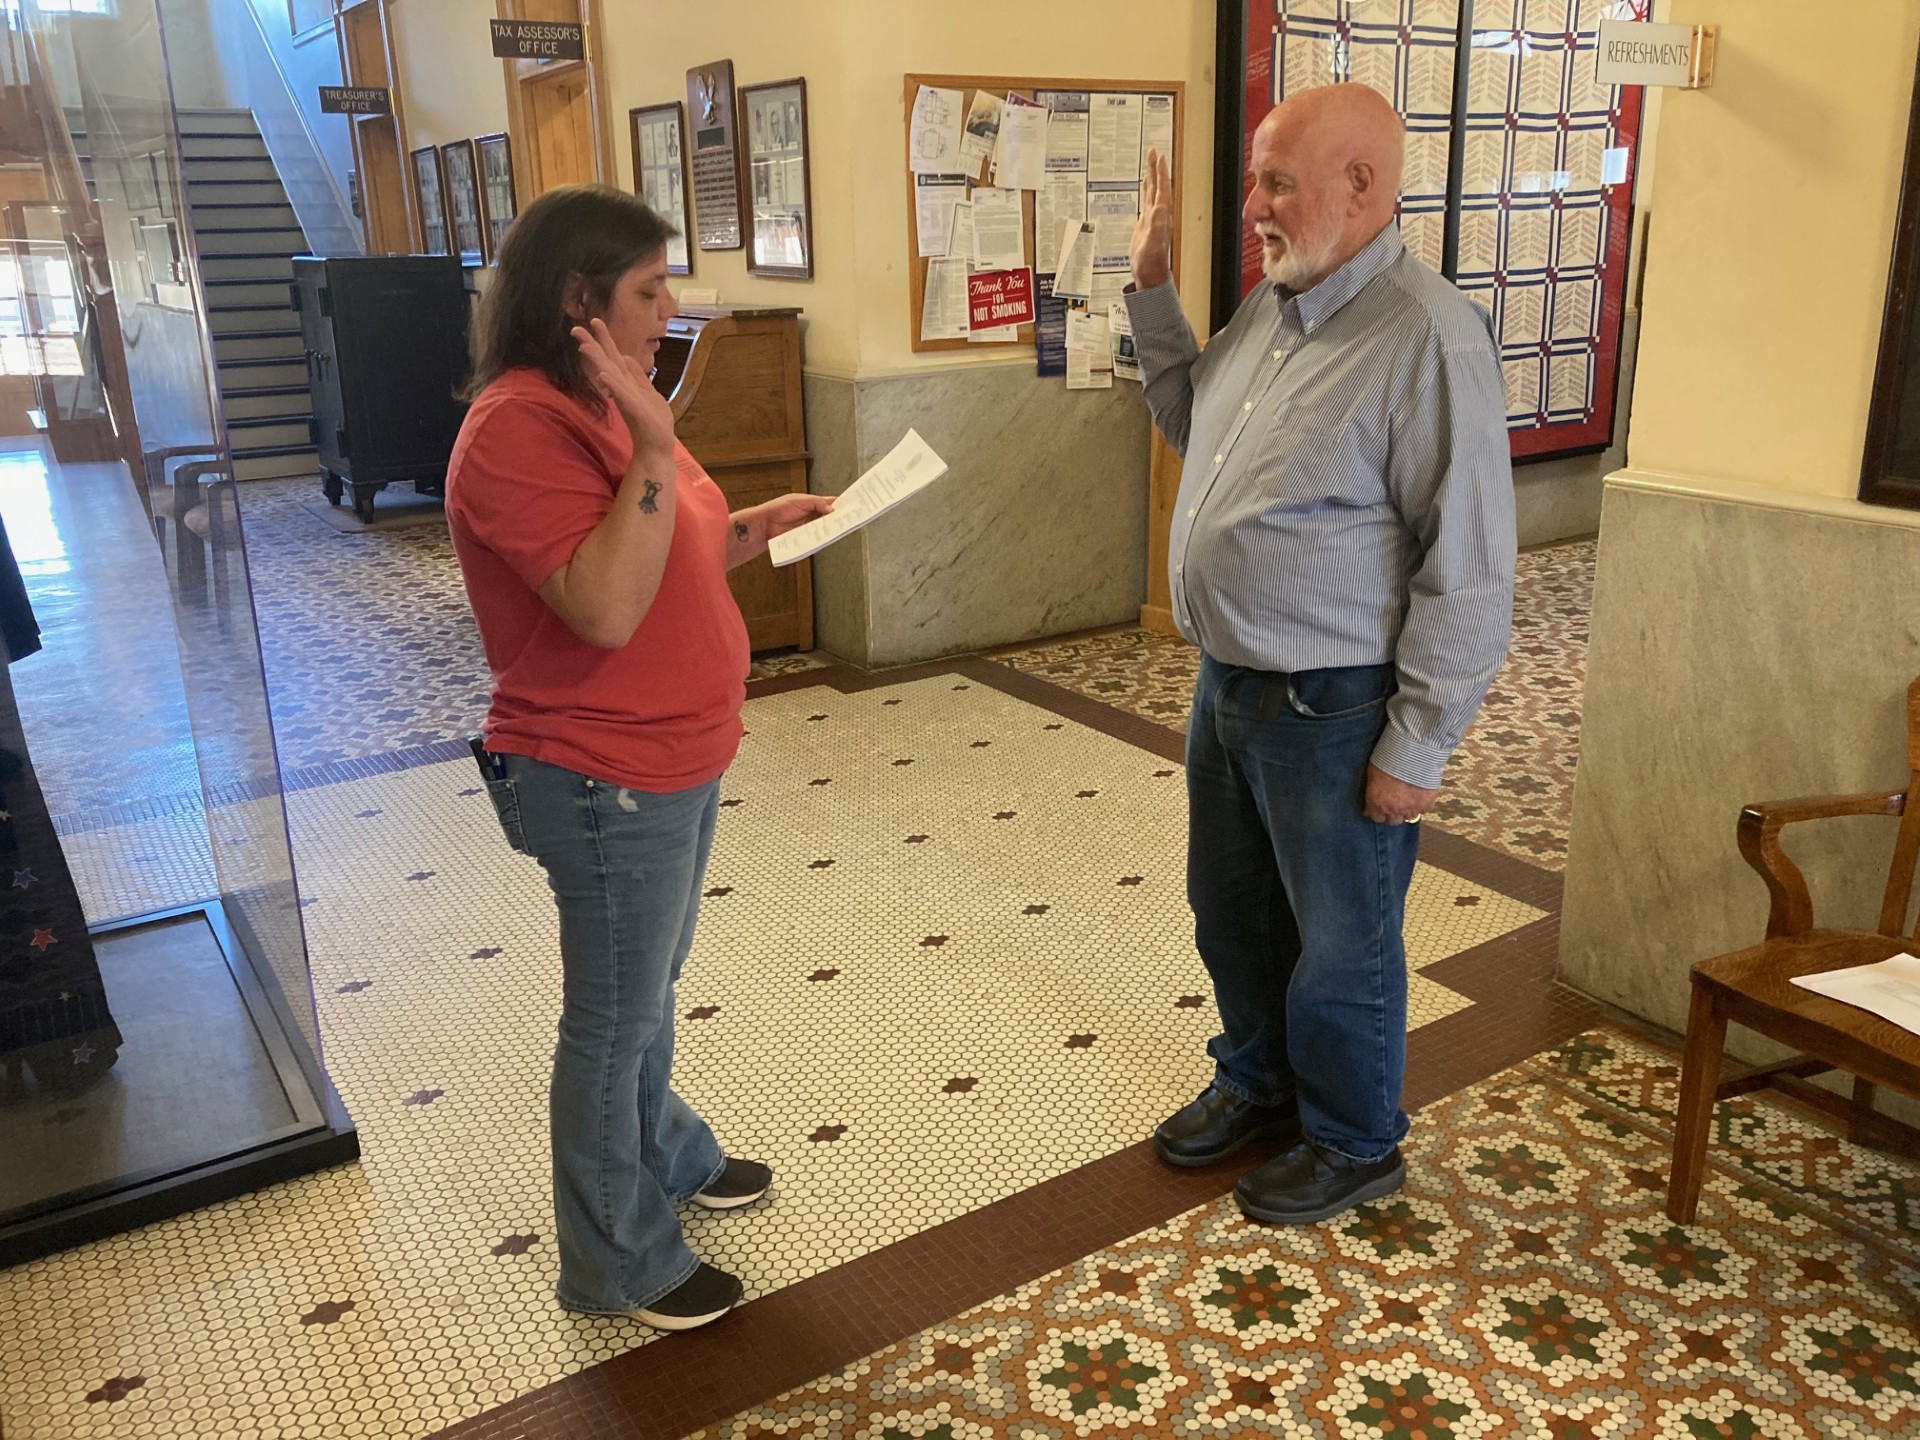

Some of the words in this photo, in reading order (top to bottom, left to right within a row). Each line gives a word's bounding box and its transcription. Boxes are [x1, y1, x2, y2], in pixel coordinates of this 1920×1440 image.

[492, 24, 513, 38] TAX
[517, 26, 580, 41] ASSESSOR'S
[519, 41, 558, 55] OFFICE
[1607, 41, 1689, 66] REFRESHMENTS
[325, 90, 384, 101] TREASURER'S
[340, 101, 371, 111] OFFICE
[969, 277, 1003, 297] Thank
[1006, 275, 1026, 290] You
[993, 294, 1005, 304] FOR
[973, 307, 989, 322] NOT
[992, 301, 1027, 318] SMOKING
